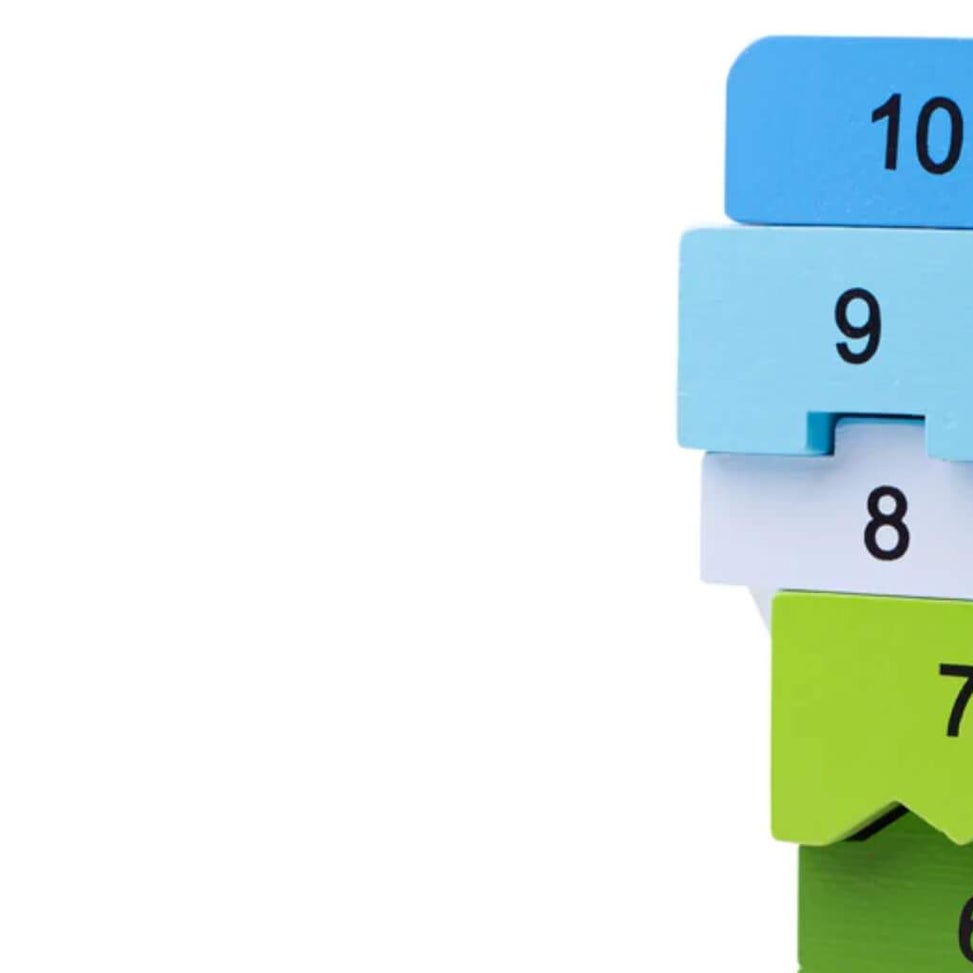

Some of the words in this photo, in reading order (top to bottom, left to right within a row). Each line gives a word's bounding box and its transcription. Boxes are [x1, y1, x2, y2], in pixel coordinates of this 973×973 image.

[871, 95, 964, 176] 10
[834, 288, 882, 365] 9
[863, 486, 911, 562] 8
